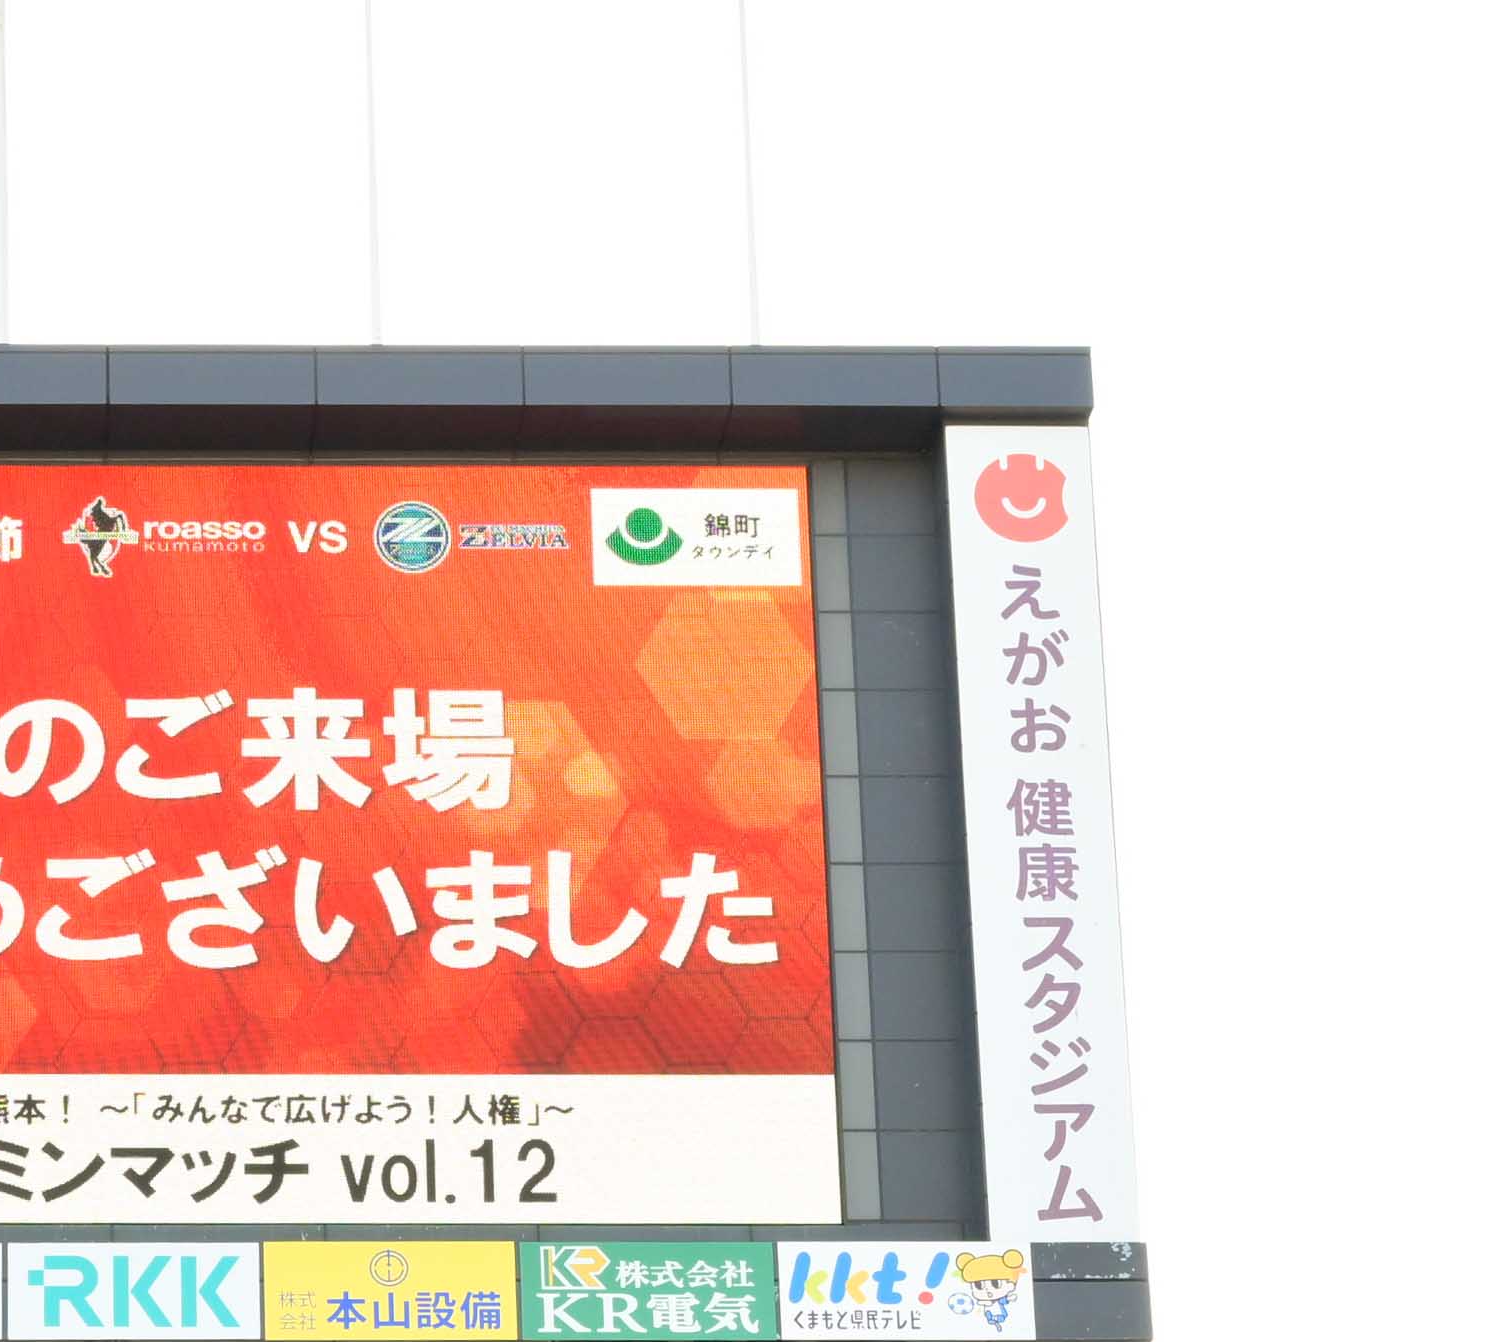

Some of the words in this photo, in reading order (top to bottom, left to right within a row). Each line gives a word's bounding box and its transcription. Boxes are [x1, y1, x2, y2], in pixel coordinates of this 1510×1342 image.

[142, 518, 266, 542] roasso
[288, 520, 349, 554] VS
[703, 512, 761, 539] 錦町
[997, 562, 1070, 755] えがお
[1002, 776, 1105, 1226] 健康スタジアム
[342, 1136, 559, 1206] vol.12
[615, 1258, 756, 1289] 株式会社
[27, 1253, 247, 1329] RKK
[279, 1290, 317, 1309] 株式
[279, 1311, 317, 1332] 会社
[326, 1288, 503, 1332] 本山設備
[534, 1289, 760, 1336] KR電気
[791, 1307, 925, 1333] くまもと県民テレビ
